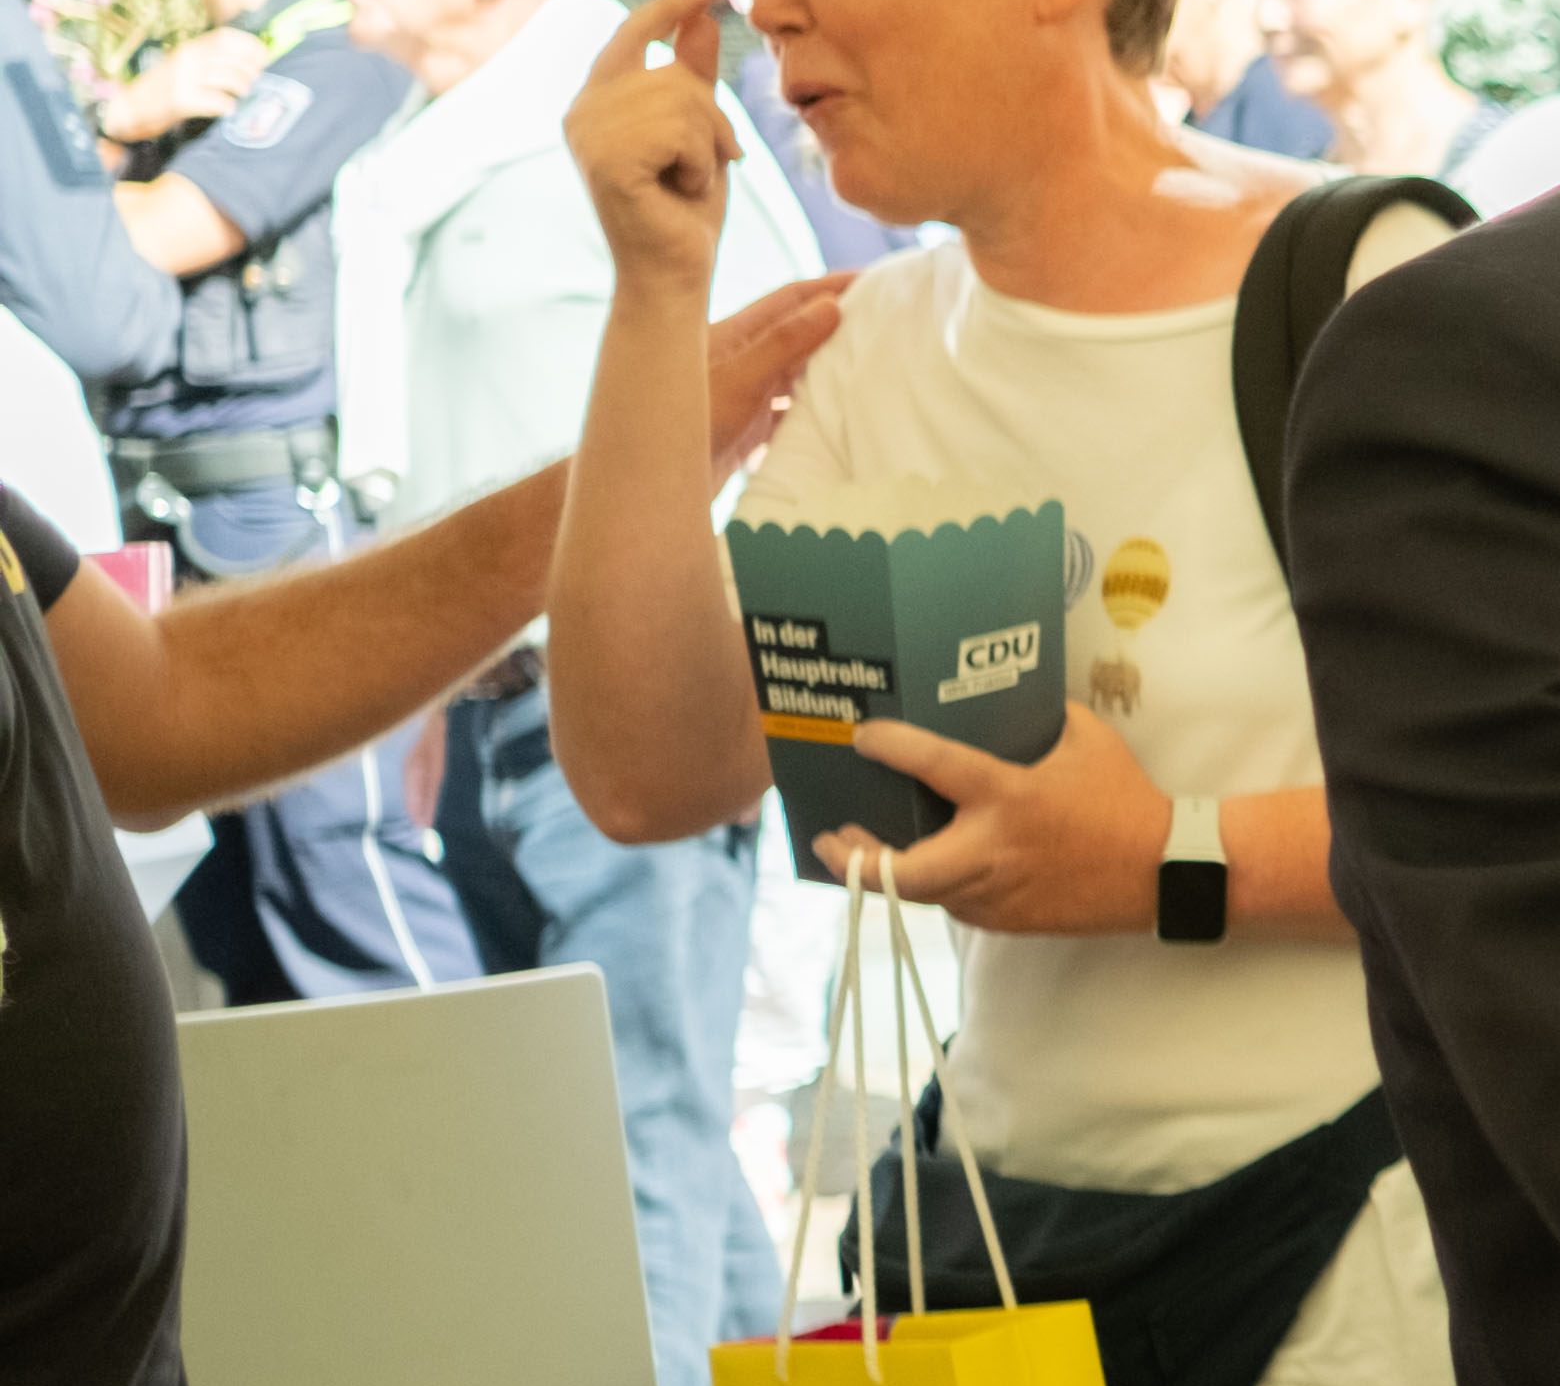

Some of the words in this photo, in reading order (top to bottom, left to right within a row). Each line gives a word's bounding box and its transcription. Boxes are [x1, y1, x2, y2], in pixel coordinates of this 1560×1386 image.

[752, 615, 774, 645] In
[779, 619, 819, 649] der
[965, 629, 1035, 670] CDU
[760, 649, 889, 690] Hauptrolle:
[766, 682, 862, 724] Bildung.
